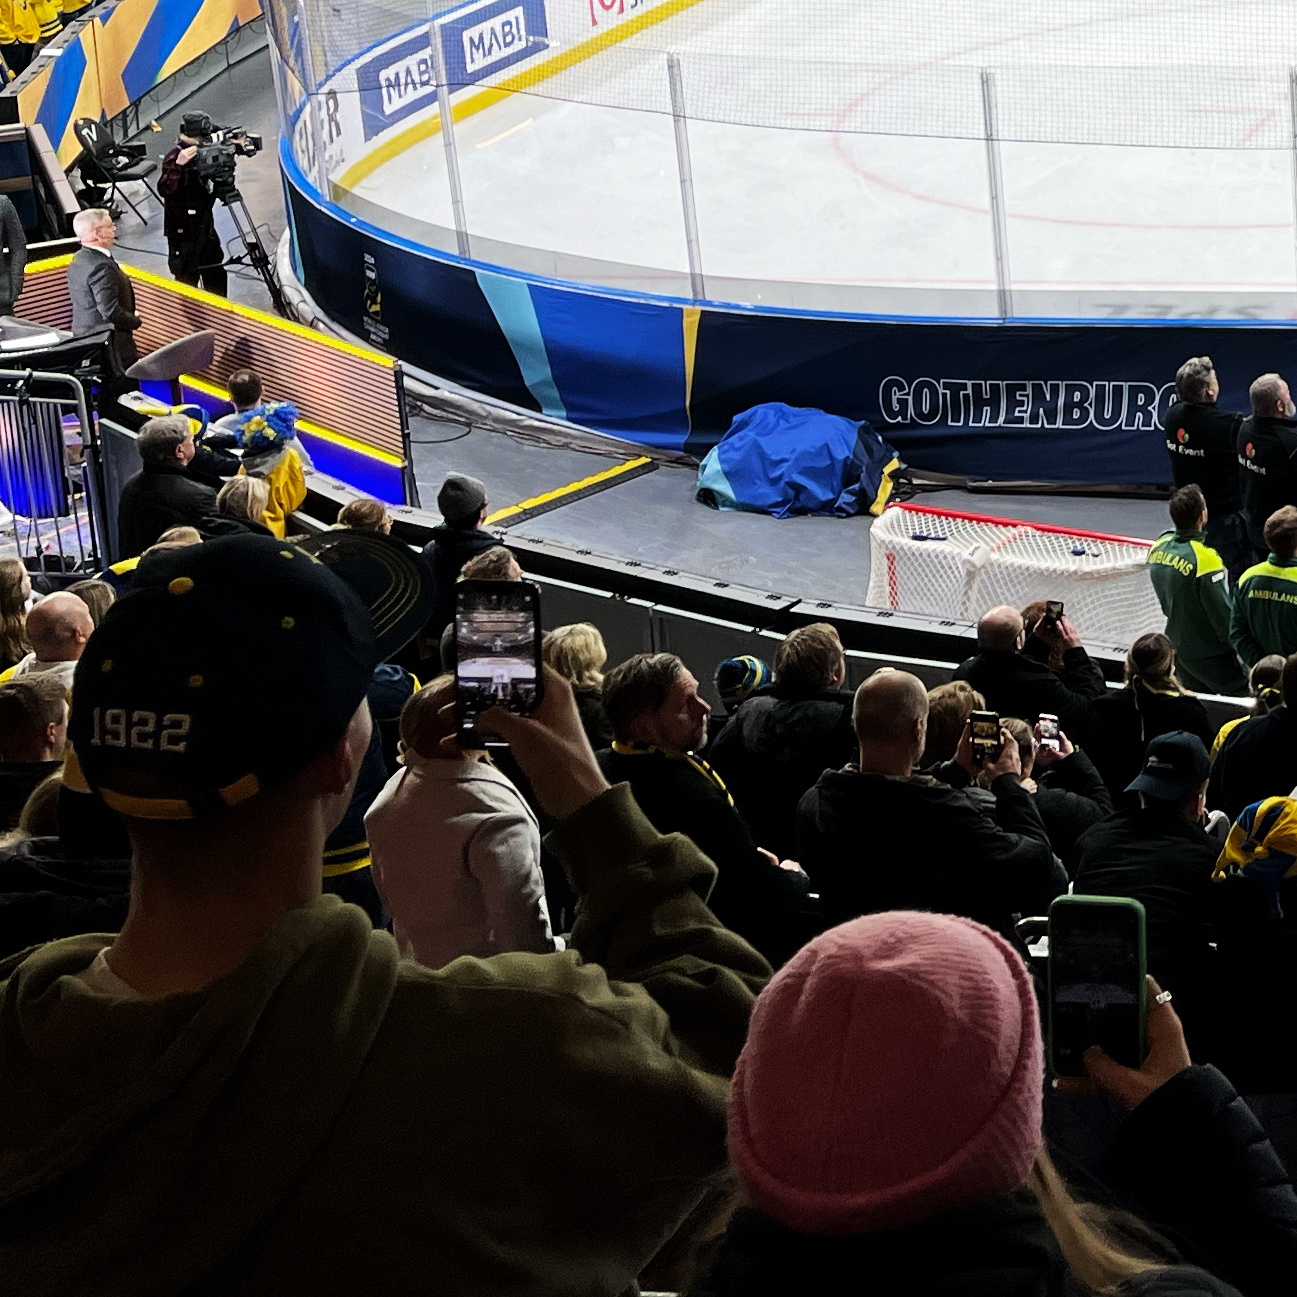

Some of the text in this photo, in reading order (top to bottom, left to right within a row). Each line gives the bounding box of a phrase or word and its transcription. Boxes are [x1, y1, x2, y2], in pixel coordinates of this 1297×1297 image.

[469, 16, 522, 64] MABI
[1178, 444, 1205, 457] Event
[91, 706, 192, 754] 1922
